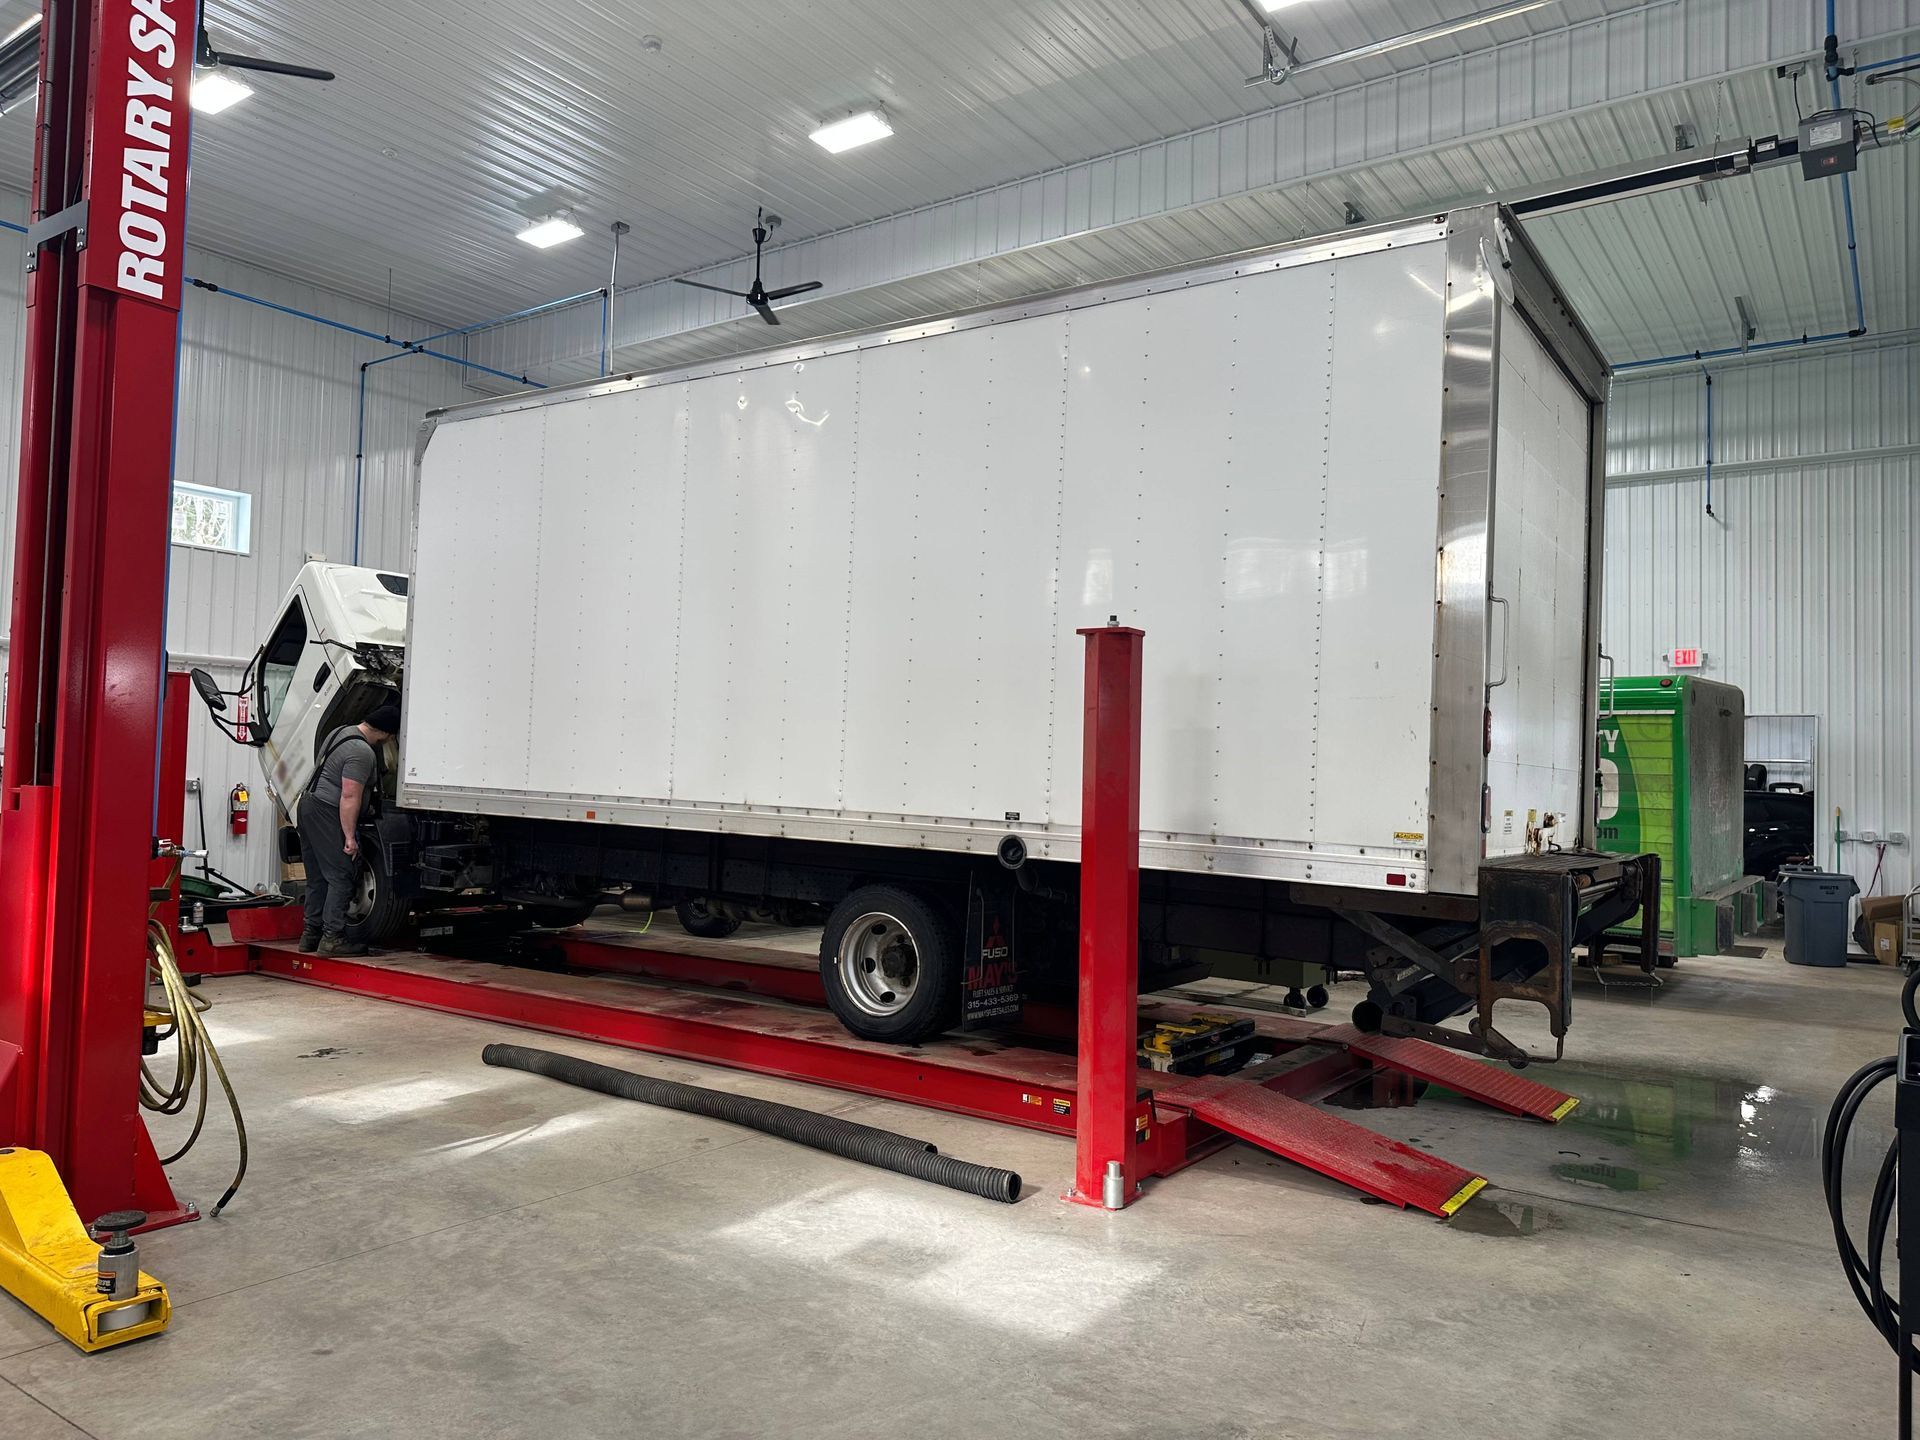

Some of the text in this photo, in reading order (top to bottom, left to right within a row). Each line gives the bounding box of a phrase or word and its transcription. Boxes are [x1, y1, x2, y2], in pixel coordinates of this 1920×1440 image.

[117, 57, 172, 300] ROTARY
[1674, 648, 1698, 666] EXIT
[982, 946, 1008, 958] FUSO
[967, 994, 1018, 1009] 315-433-5369
